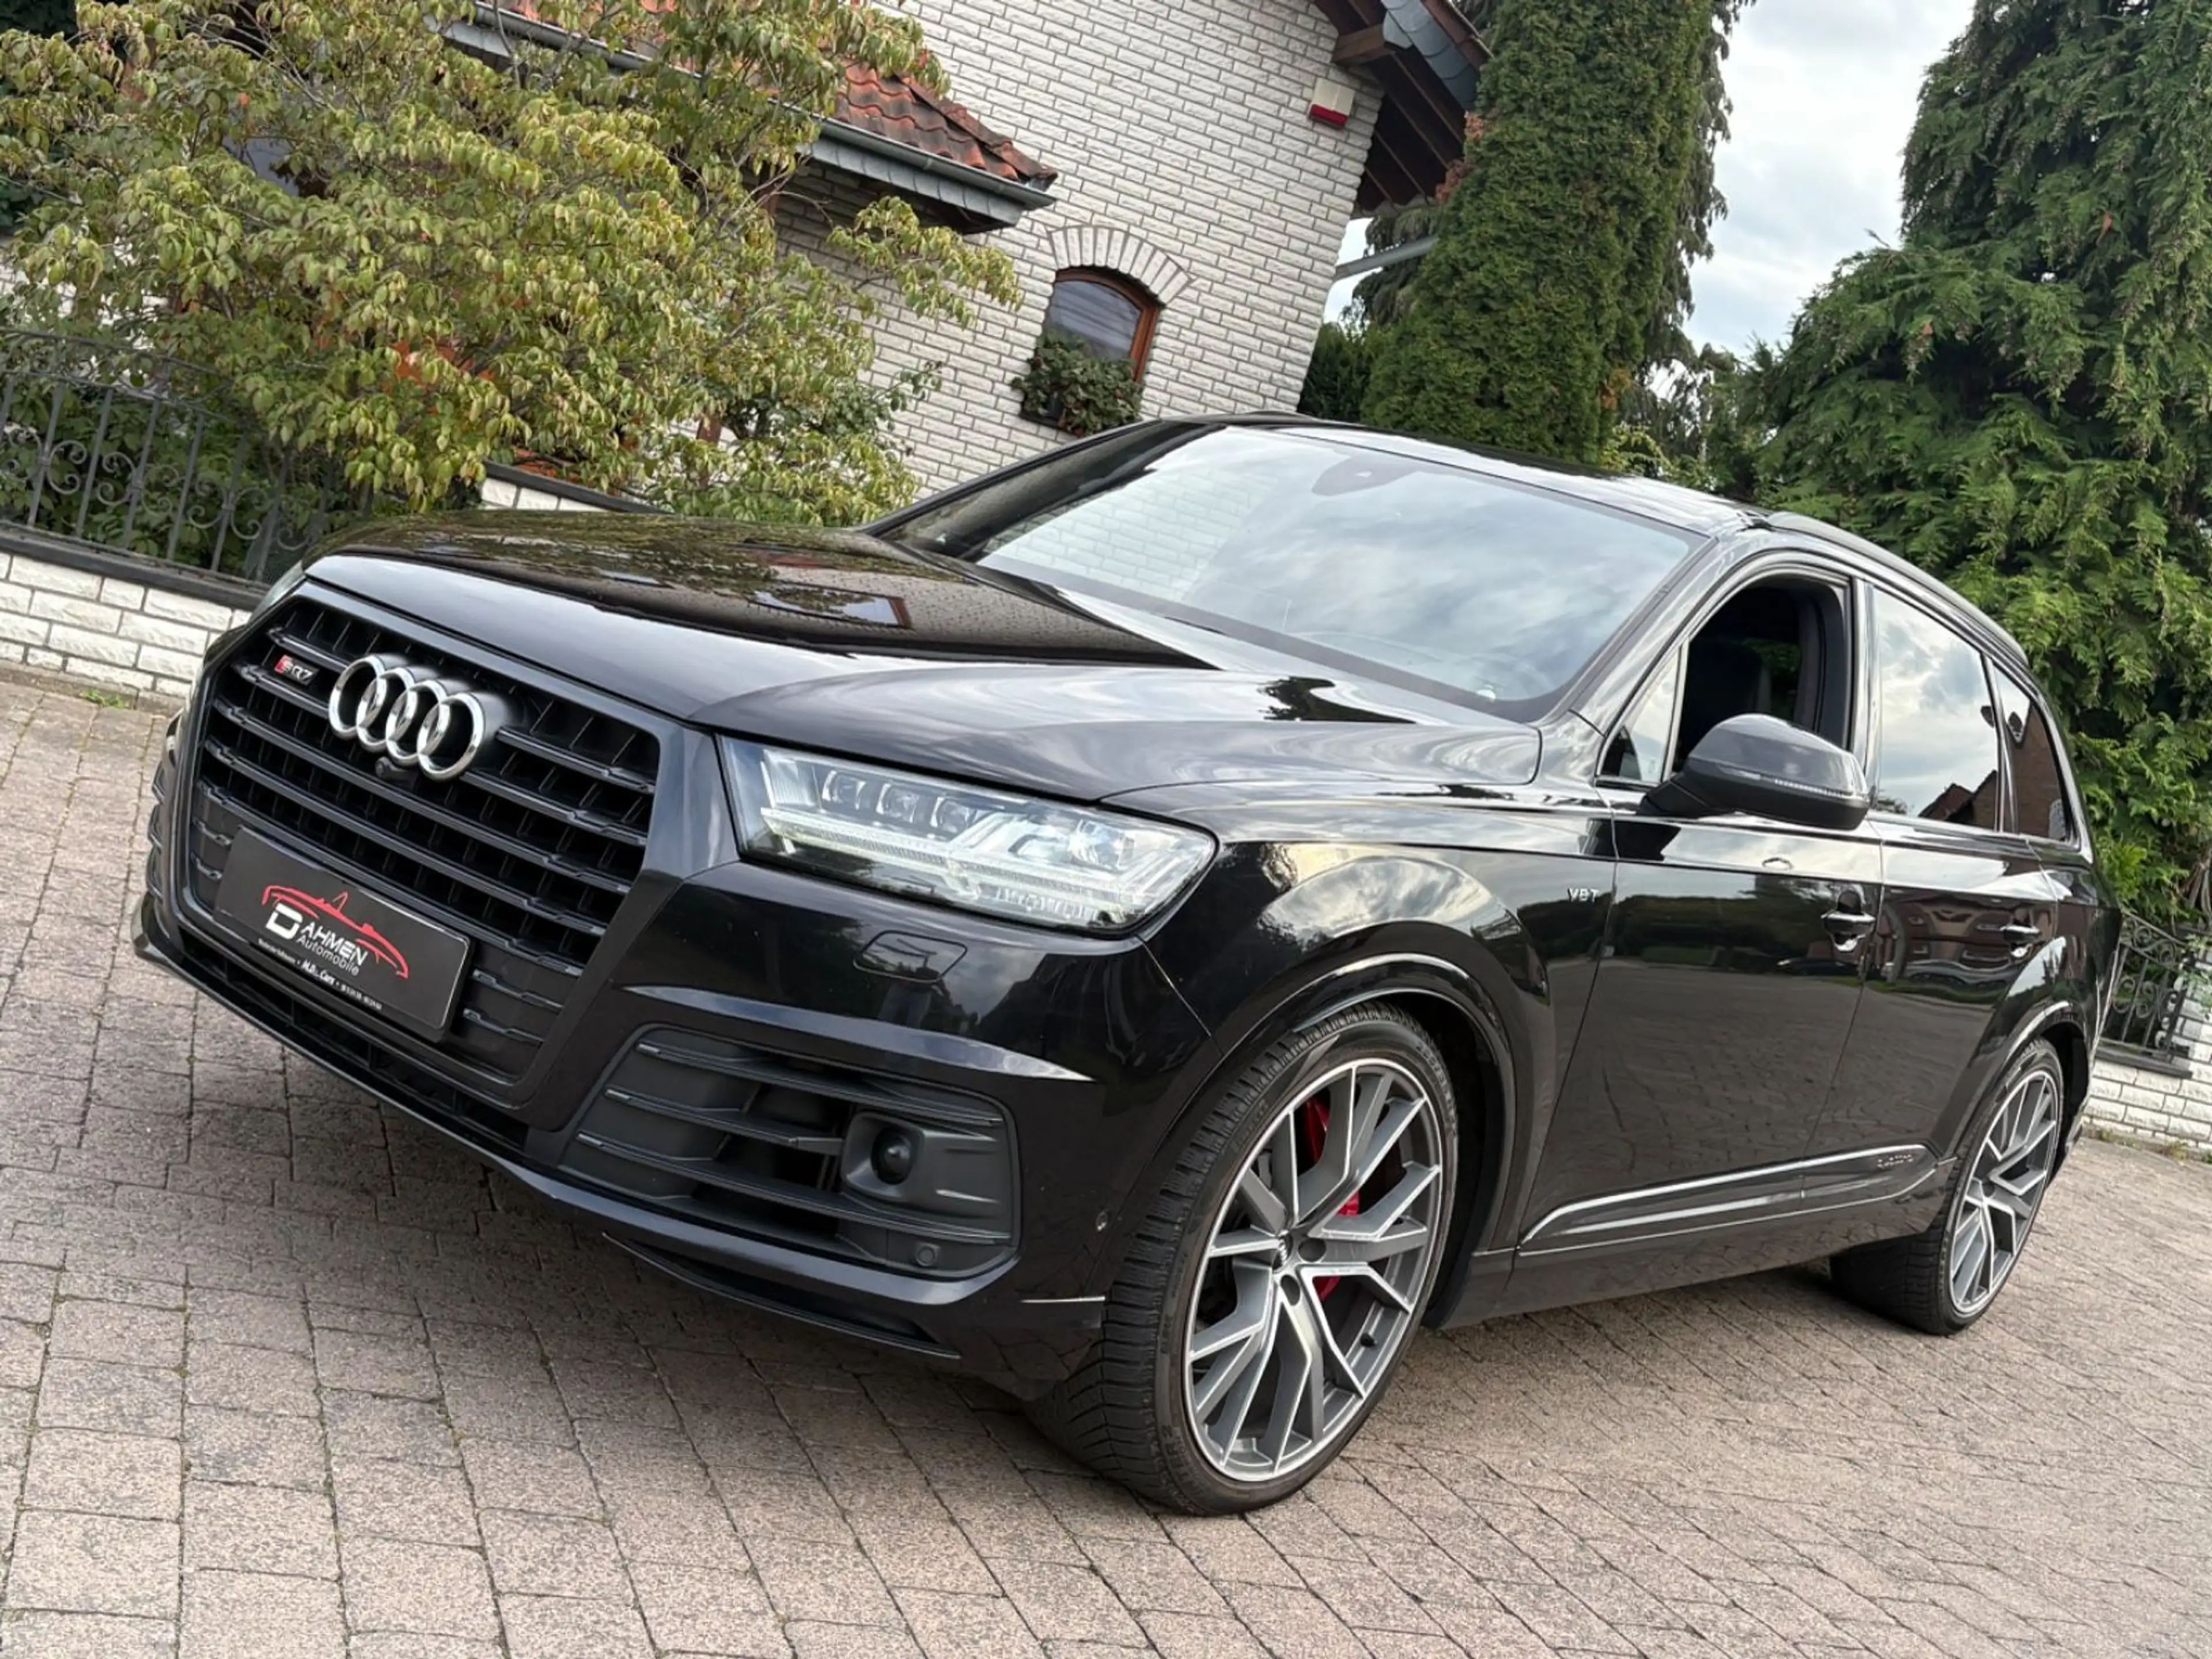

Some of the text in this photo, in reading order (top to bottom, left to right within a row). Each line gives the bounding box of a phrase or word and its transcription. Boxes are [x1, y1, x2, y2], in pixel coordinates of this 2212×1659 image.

[1568, 887, 1599, 903] V8T
[265, 902, 369, 965] DAHMEN
[296, 934, 359, 976] Automobile
